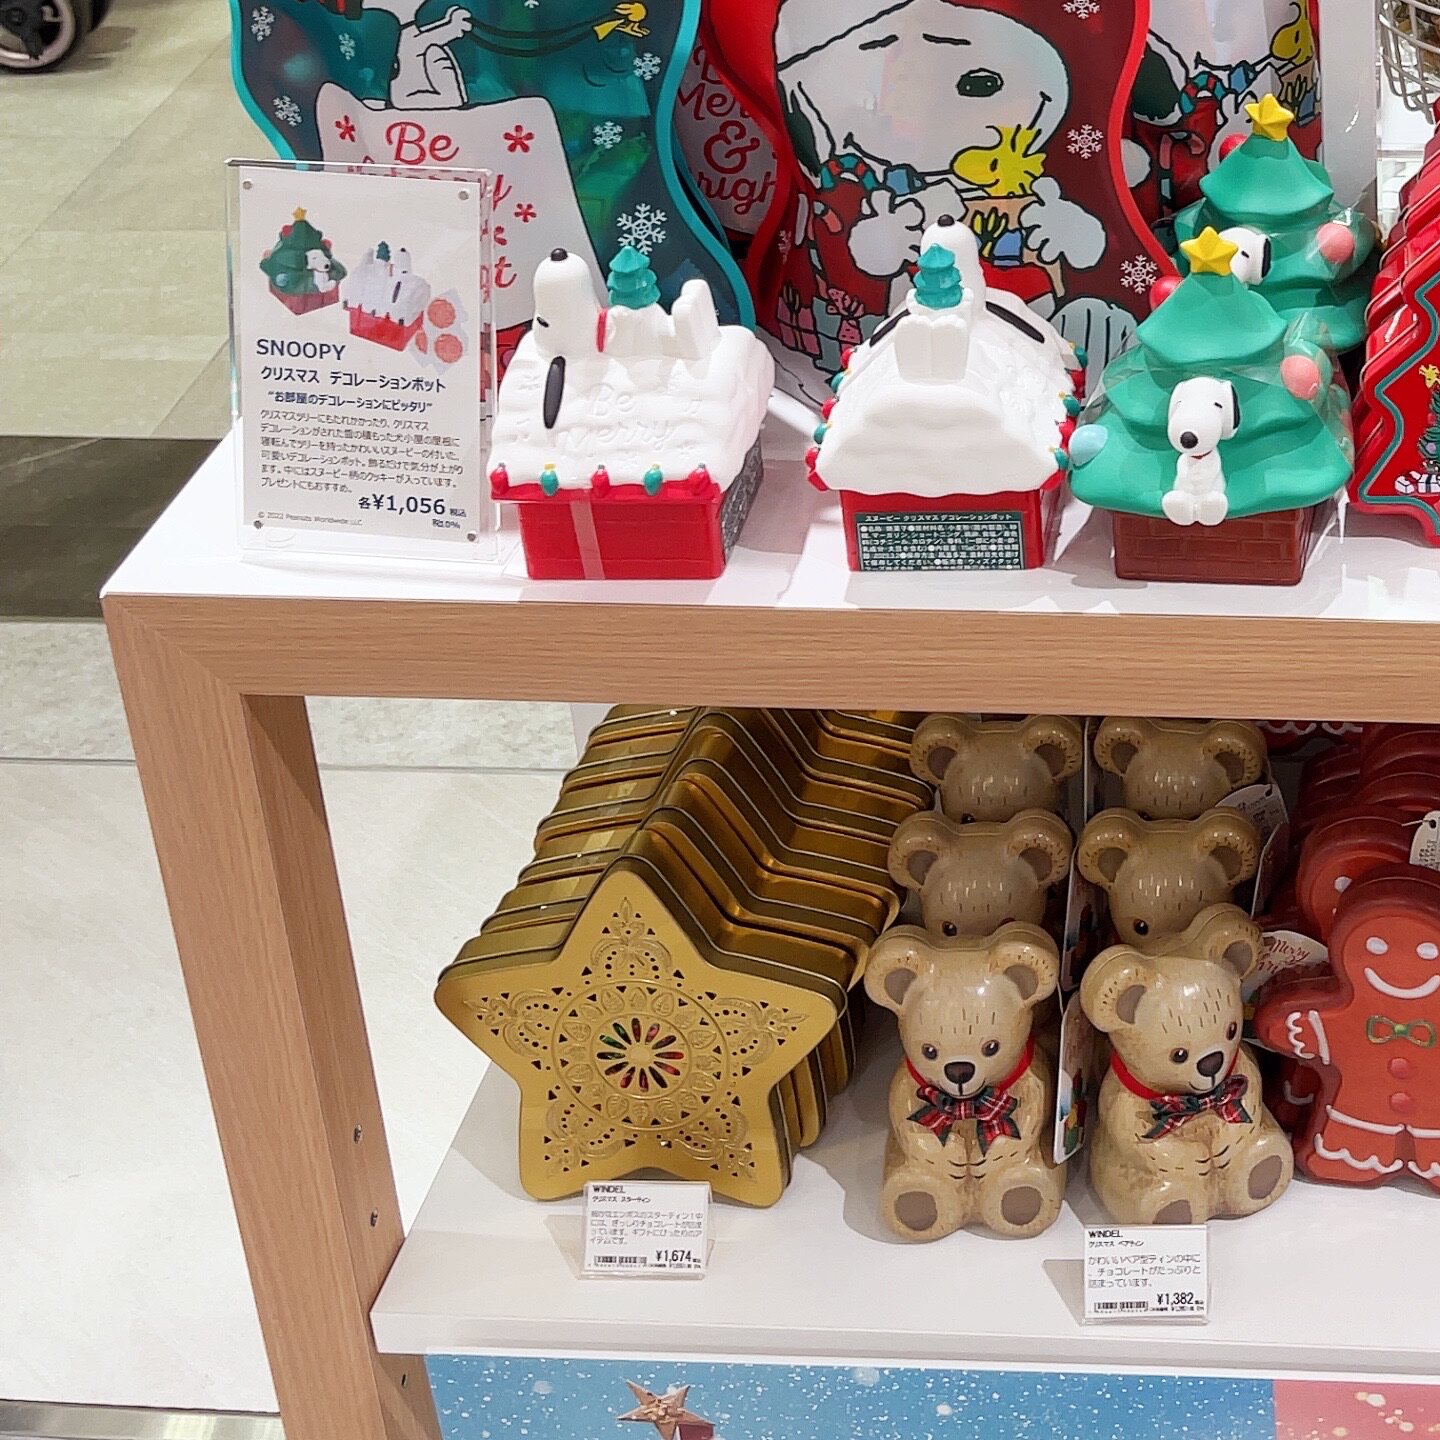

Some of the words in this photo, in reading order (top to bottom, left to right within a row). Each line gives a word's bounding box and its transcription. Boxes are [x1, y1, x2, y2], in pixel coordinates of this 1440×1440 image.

[385, 122, 460, 166] Be
[256, 338, 346, 360] SNOOPY
[261, 366, 320, 384] クリスマス
